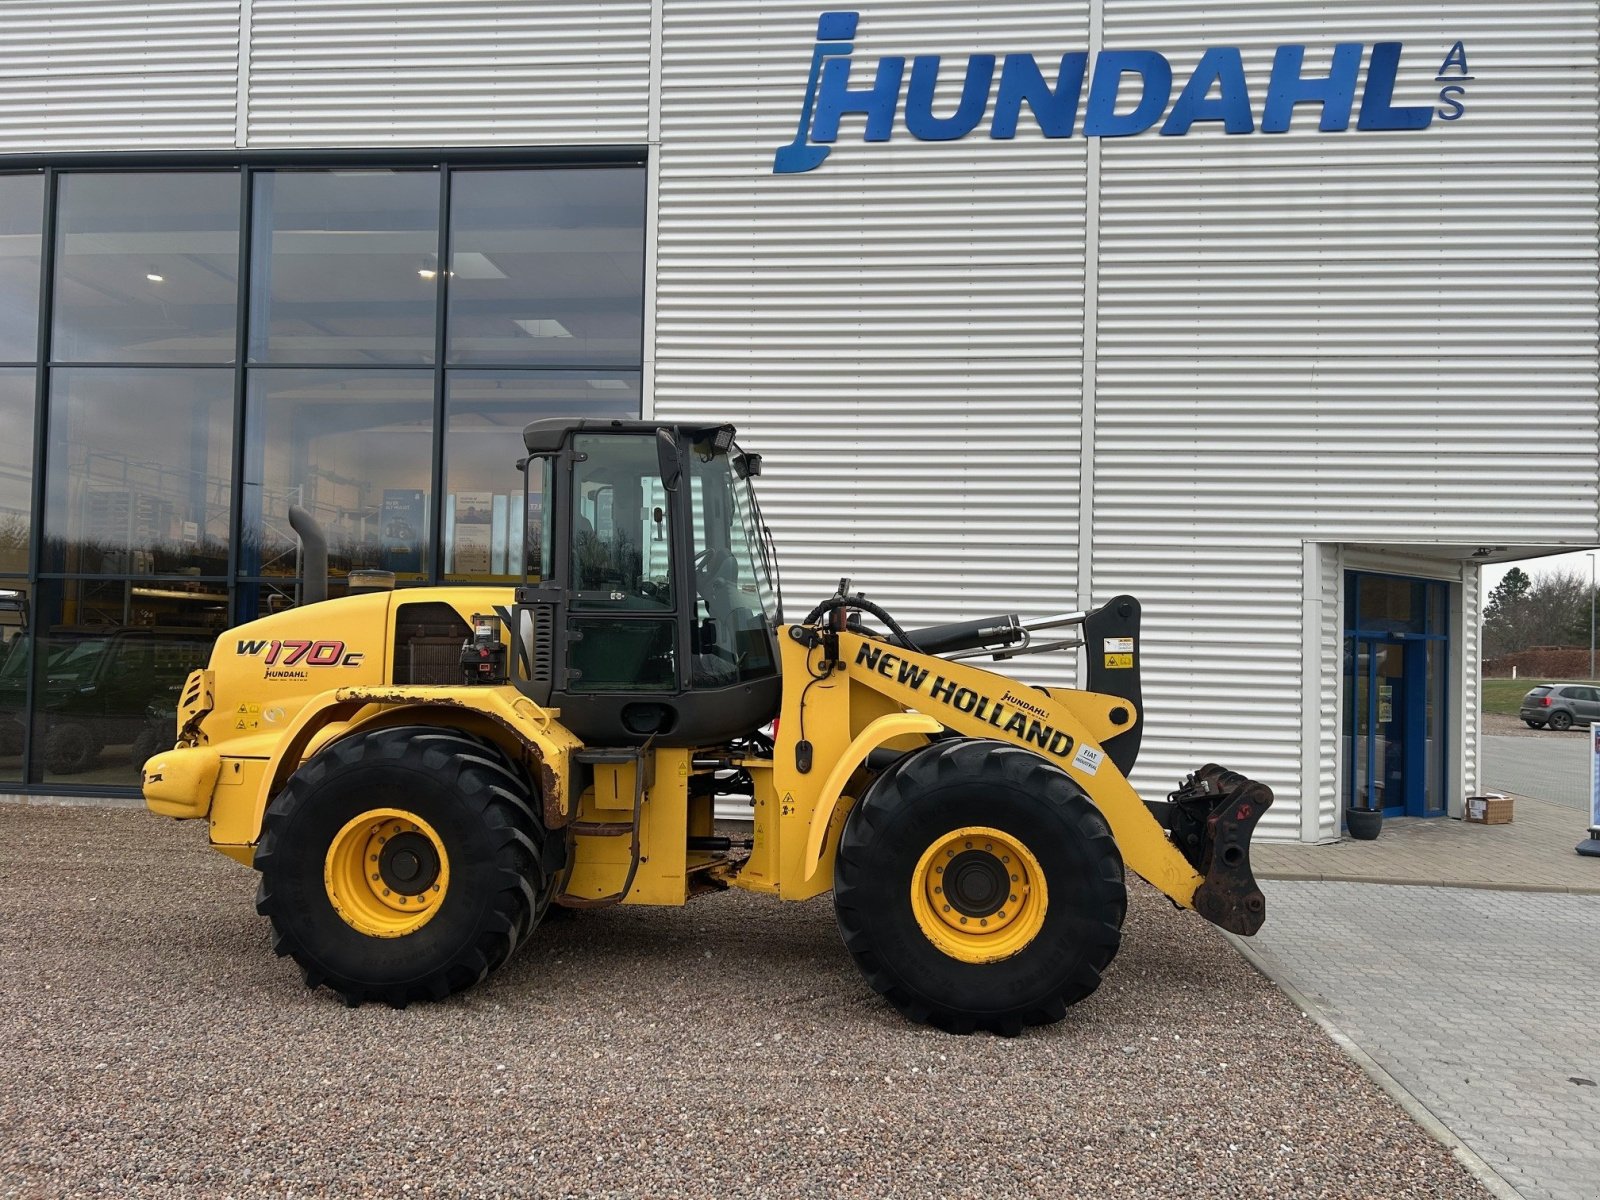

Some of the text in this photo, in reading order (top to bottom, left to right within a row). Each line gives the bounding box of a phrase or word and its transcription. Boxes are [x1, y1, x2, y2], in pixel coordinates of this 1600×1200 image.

[855, 642, 1075, 758] NEW HOLLAND
[1083, 749, 1098, 761] FIAT
